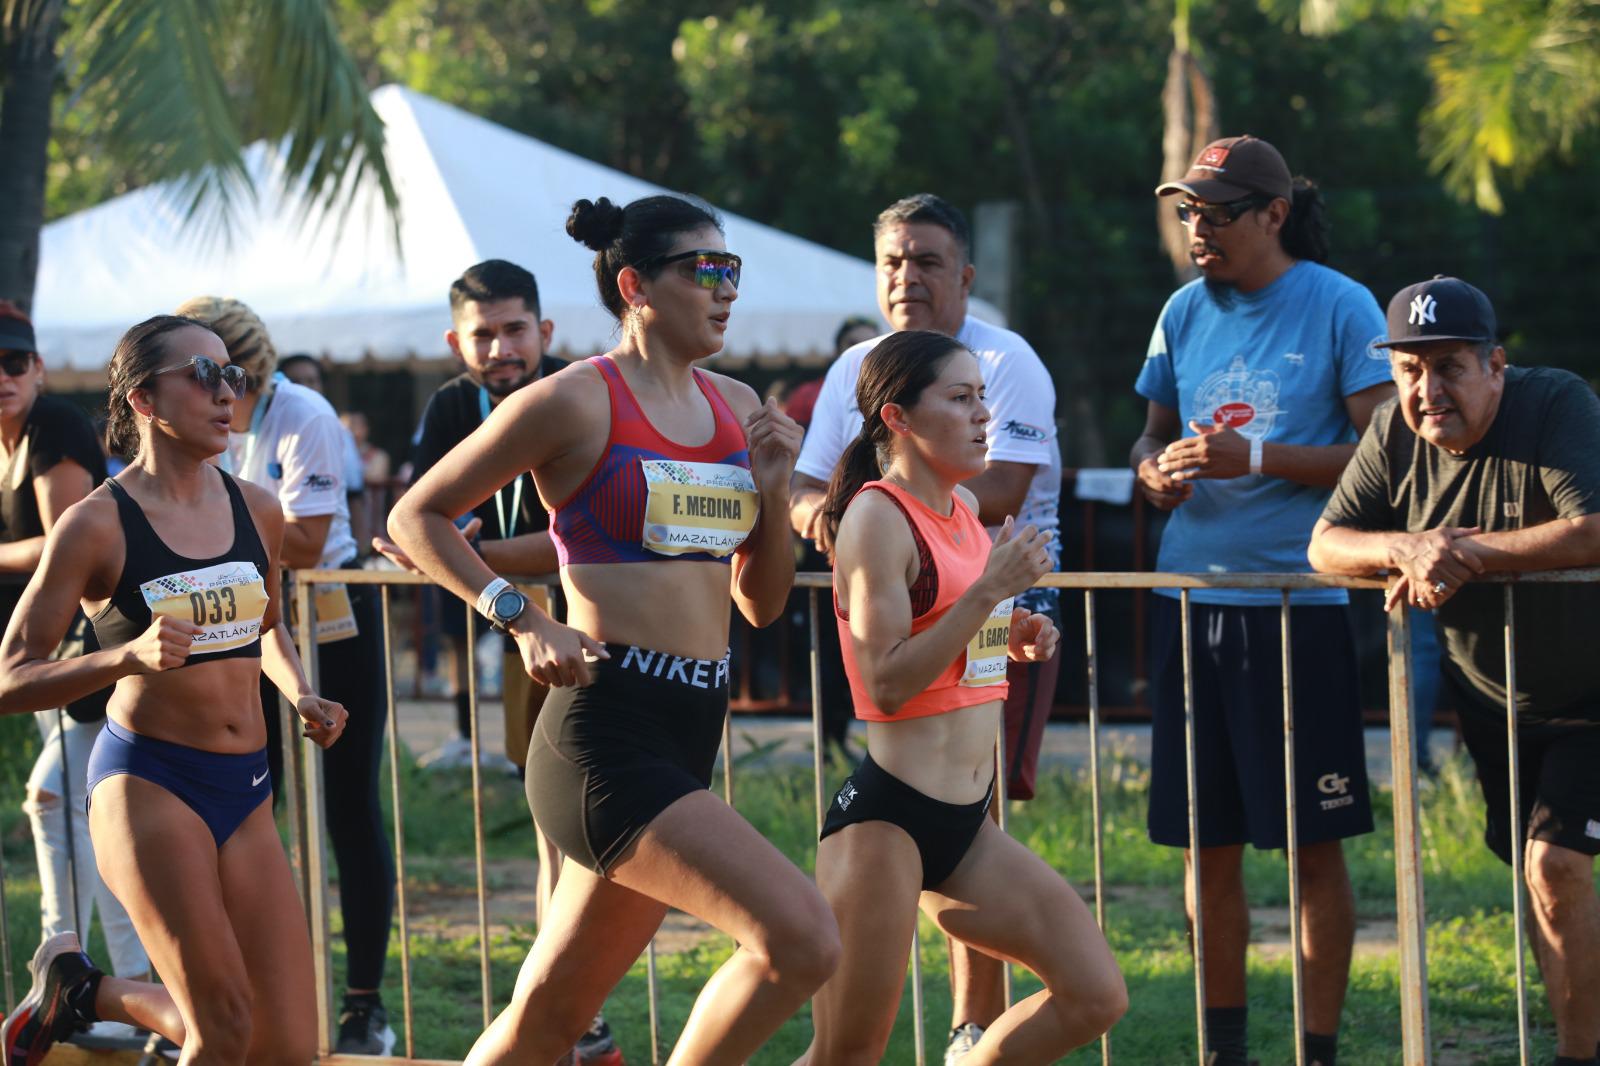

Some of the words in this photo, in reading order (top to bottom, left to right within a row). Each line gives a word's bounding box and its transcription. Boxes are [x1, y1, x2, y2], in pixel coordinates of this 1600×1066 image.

[1408, 294, 1437, 325] NY
[673, 494, 683, 515] F.
[686, 495, 742, 520] MEDINA
[190, 586, 237, 626] 033
[191, 624, 248, 642] AZATLÁN
[986, 626, 1009, 648] GARC
[620, 645, 711, 689] NIKE
